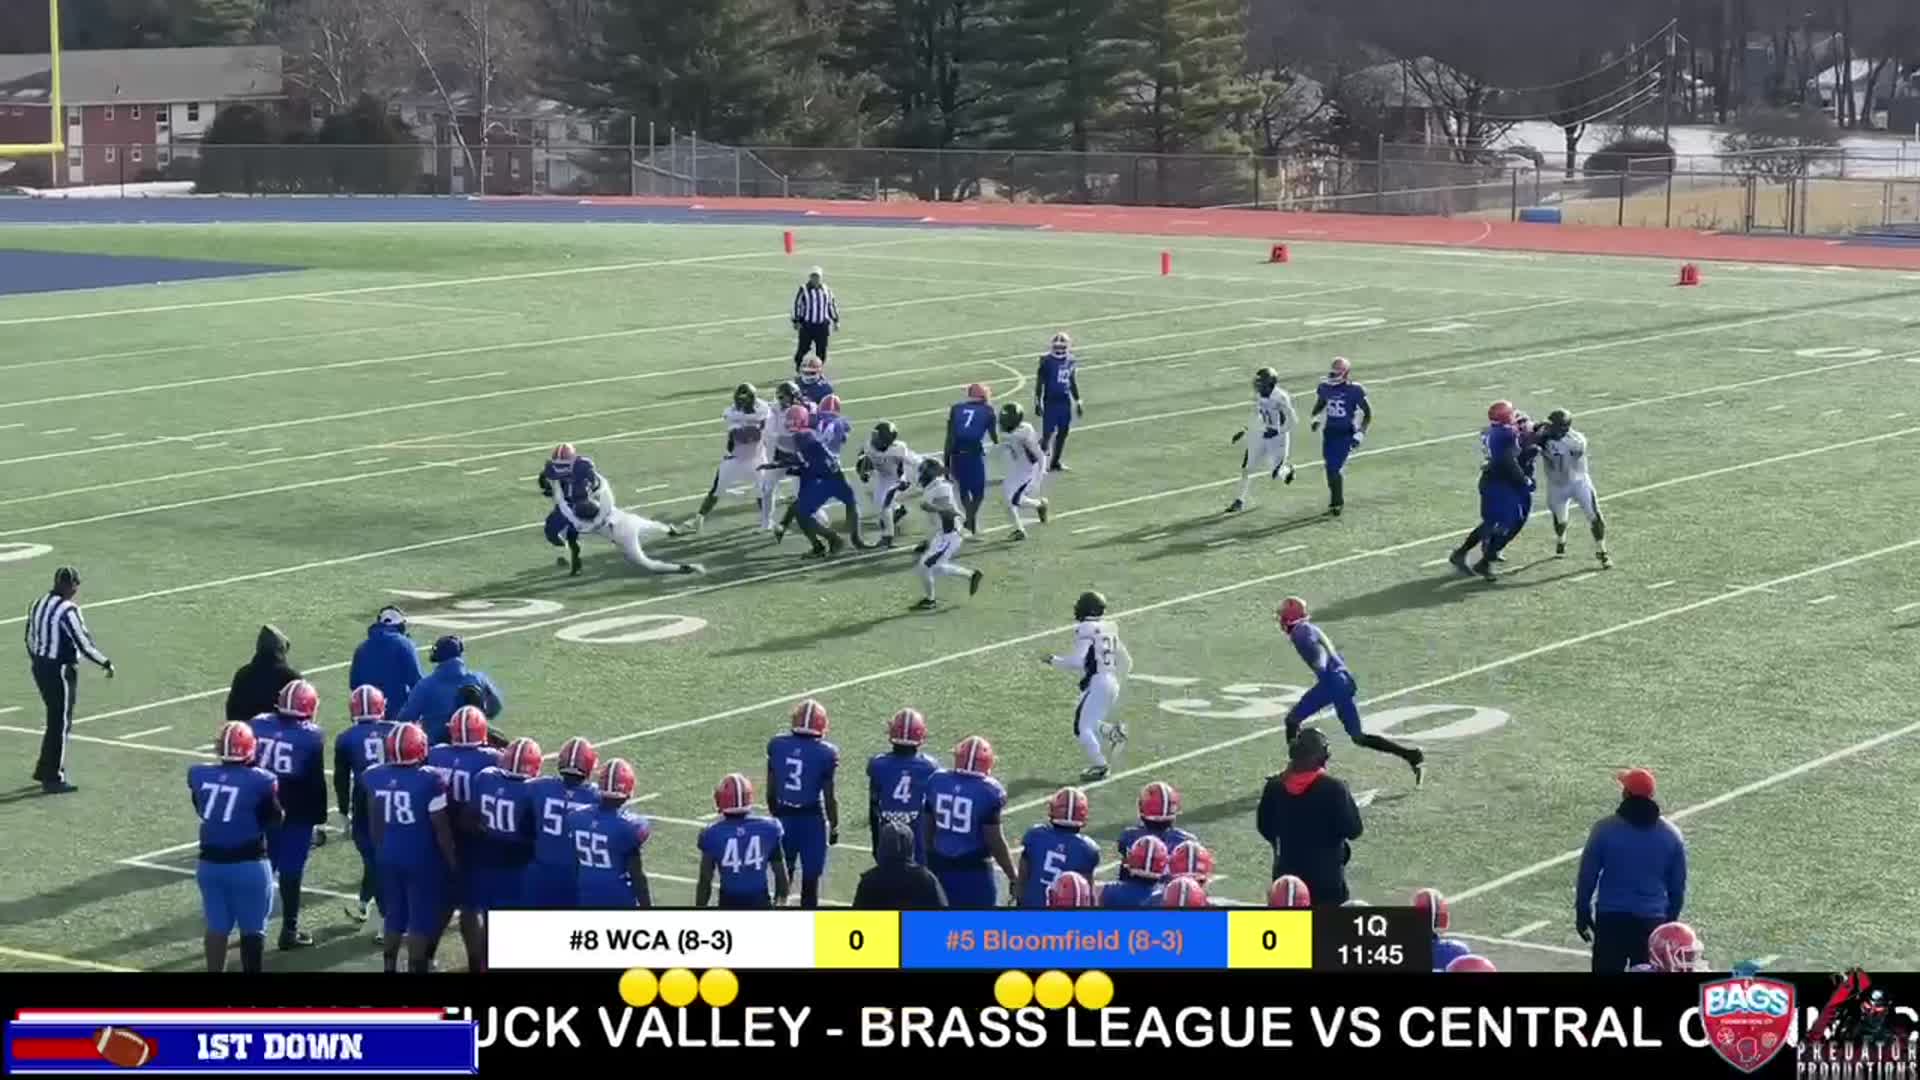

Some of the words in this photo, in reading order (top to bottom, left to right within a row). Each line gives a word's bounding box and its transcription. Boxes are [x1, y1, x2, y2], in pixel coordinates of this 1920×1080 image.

[963, 409, 975, 428] 7
[257, 737, 293, 774] 76
[785, 758, 803, 791] 3
[893, 776, 911, 802] 4
[201, 783, 239, 822] 77
[375, 791, 416, 824] 78
[481, 794, 516, 833] 50
[936, 794, 973, 834] 59
[575, 830, 612, 869] 55
[721, 835, 765, 873] 44
[1040, 850, 1067, 885] 5
